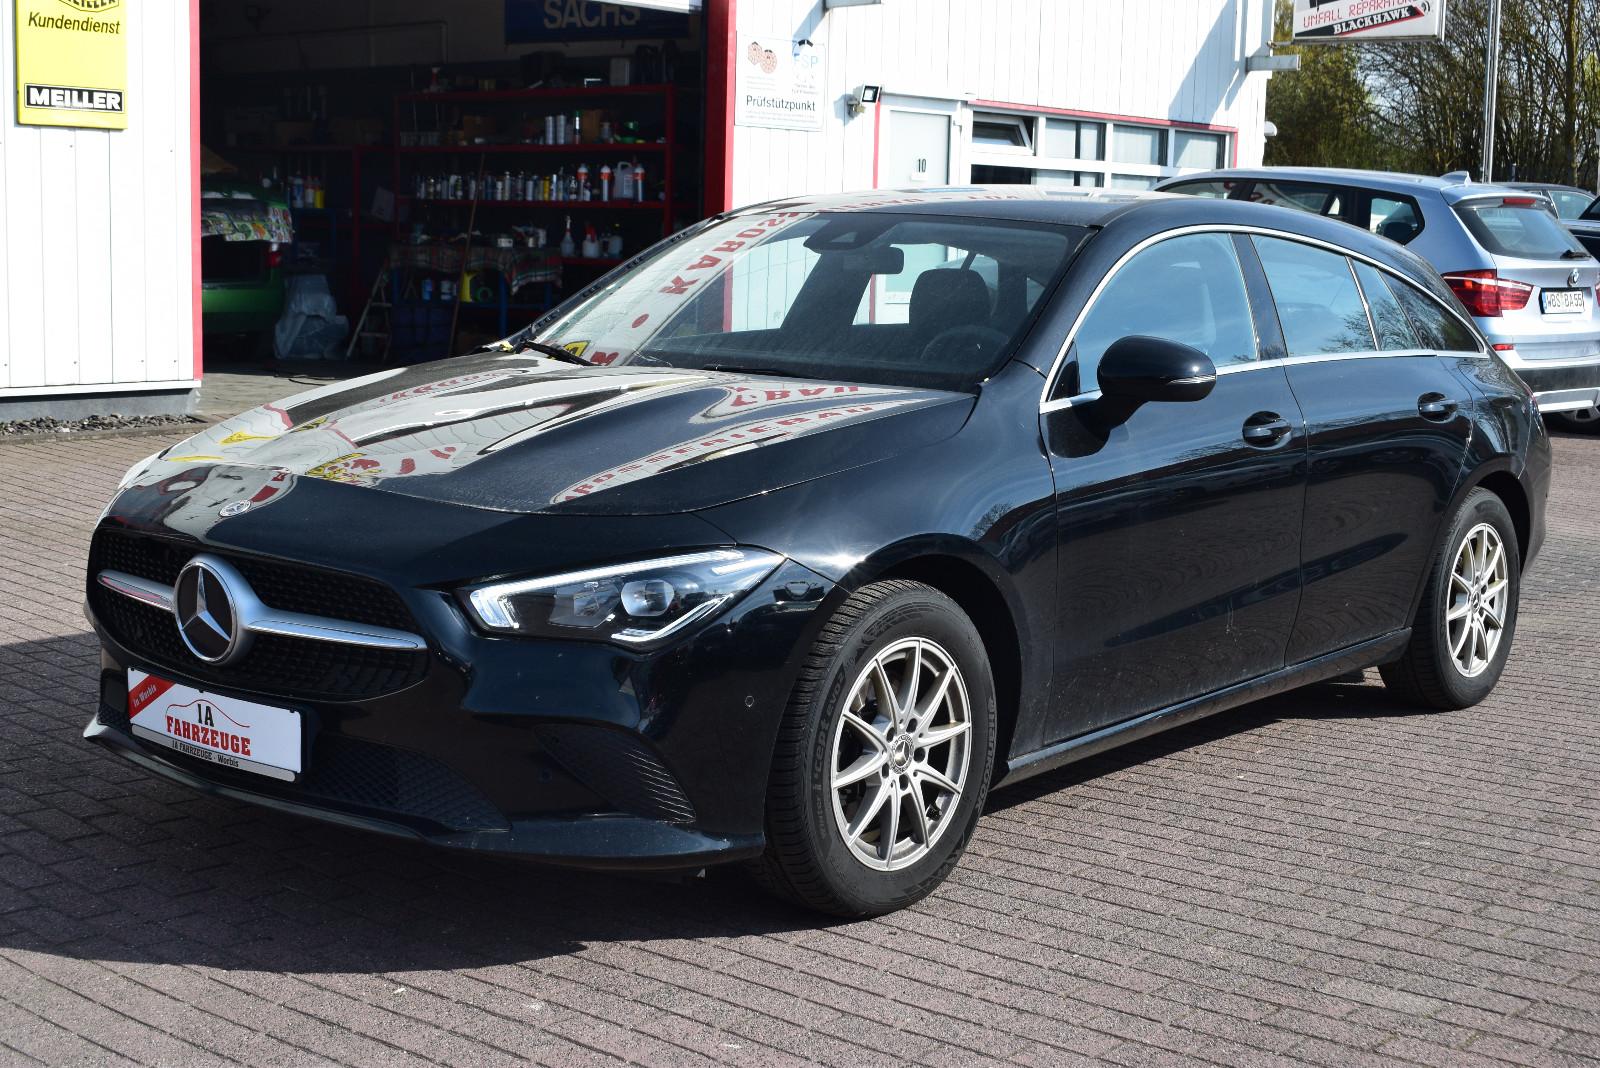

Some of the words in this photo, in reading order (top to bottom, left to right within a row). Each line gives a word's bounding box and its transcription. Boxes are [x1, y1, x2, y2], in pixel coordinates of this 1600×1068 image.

[28, 11, 120, 34] Kundendienst
[1333, 7, 1410, 35] BLACKHAWK
[29, 87, 121, 110] MEILLER
[918, 158, 927, 173] 10
[166, 714, 252, 757] FAHRZEUGE
[179, 741, 213, 761] FAHRZEUGE
[217, 754, 240, 768] Worbis
